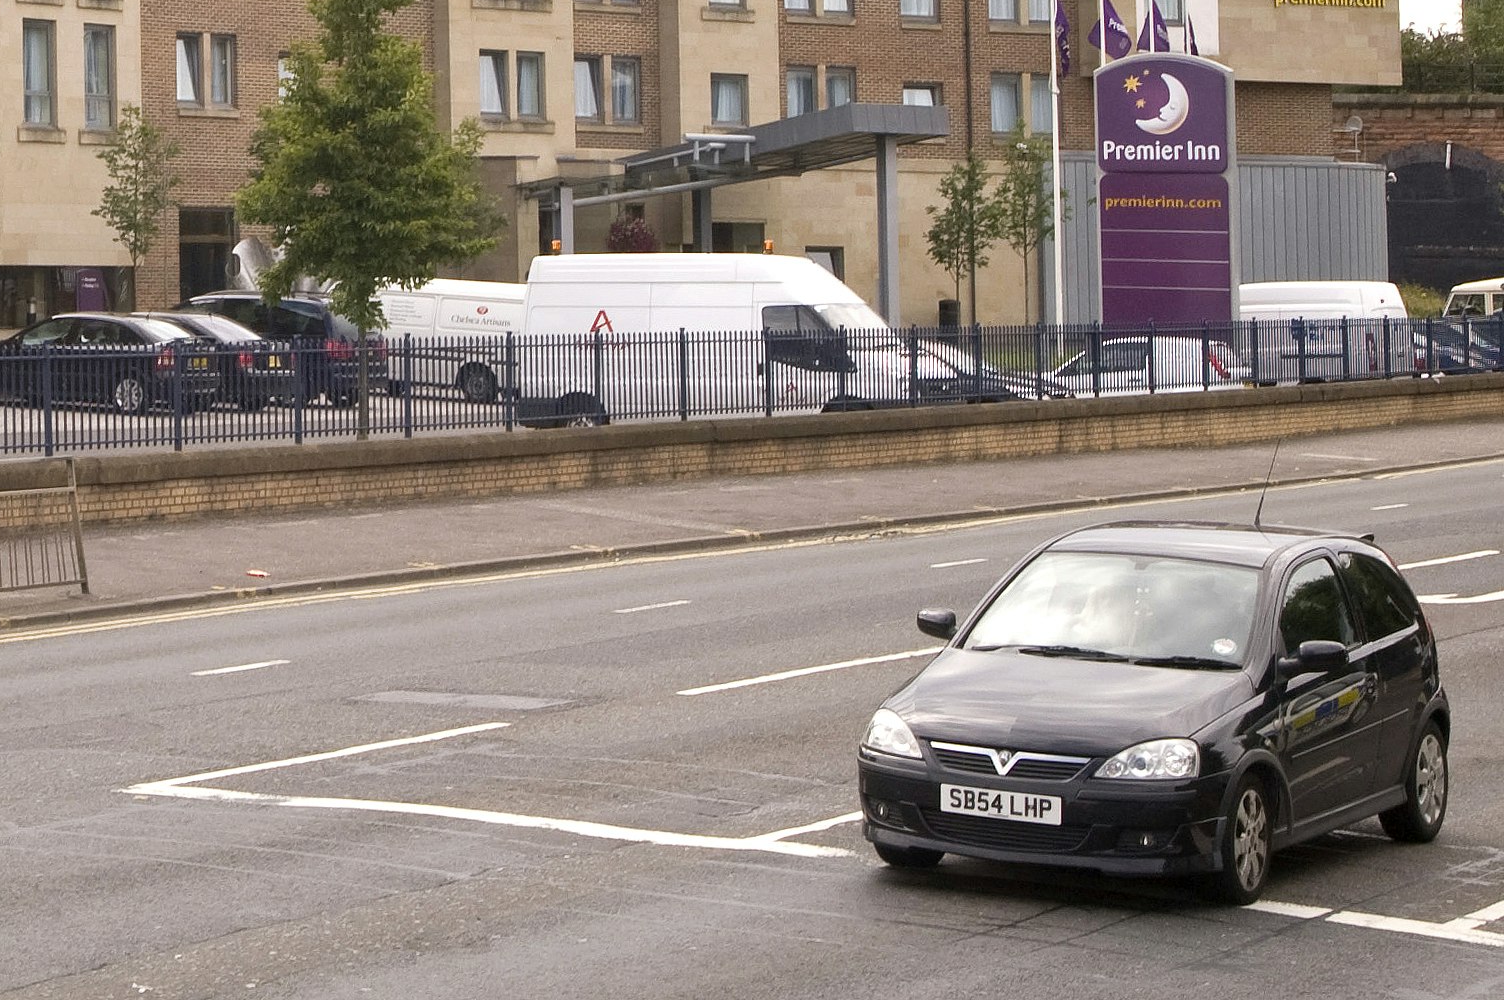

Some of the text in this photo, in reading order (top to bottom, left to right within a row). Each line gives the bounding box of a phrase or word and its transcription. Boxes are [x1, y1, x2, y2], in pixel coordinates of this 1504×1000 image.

[1103, 140, 1220, 160] Premier Inn
[1105, 195, 1222, 210] premierinn.com
[949, 788, 1052, 818] SB54 LHP
